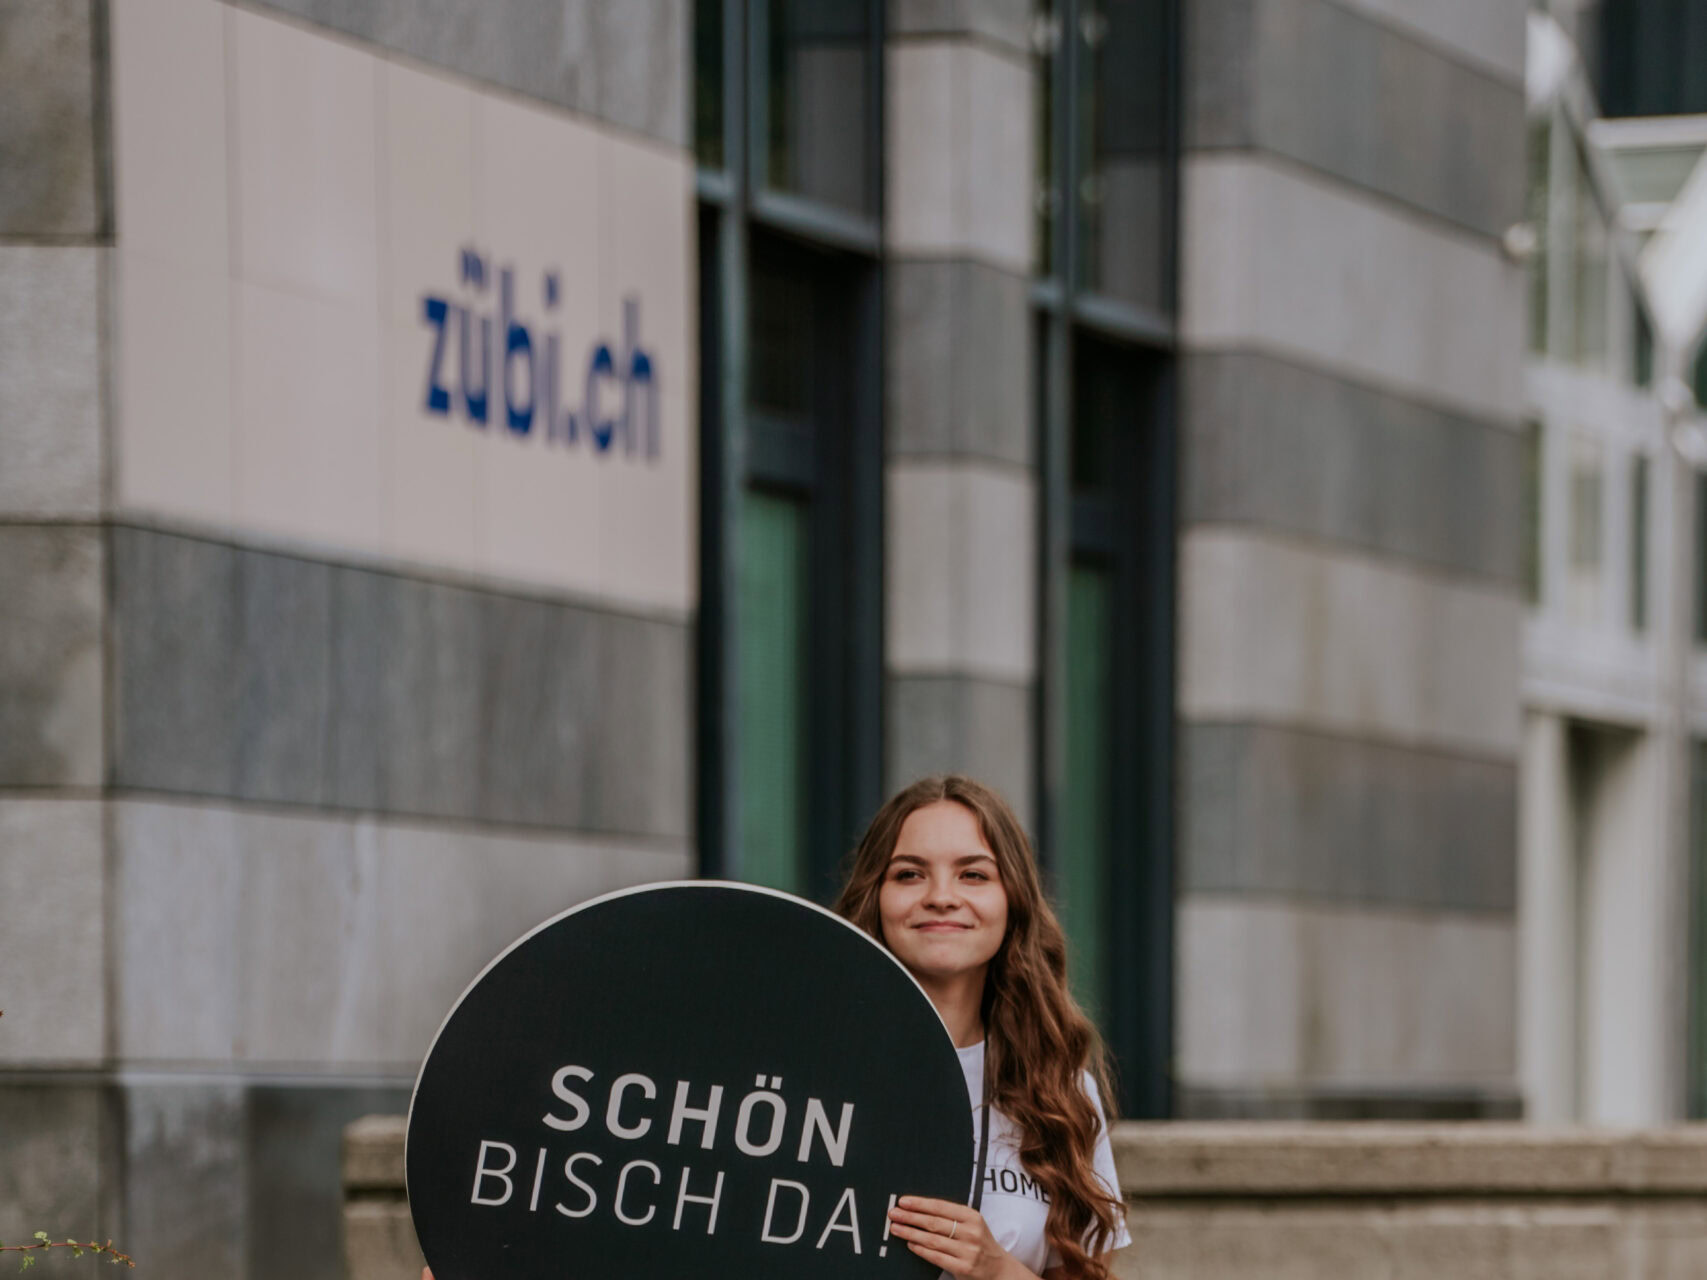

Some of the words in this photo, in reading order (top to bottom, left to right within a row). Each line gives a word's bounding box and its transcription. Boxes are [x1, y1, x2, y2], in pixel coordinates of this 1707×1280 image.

[421, 246, 662, 461] zübi.ch
[542, 1064, 855, 1167] SCHÖN
[470, 1139, 725, 1236] BISCH
[760, 1177, 898, 1258] DA!
